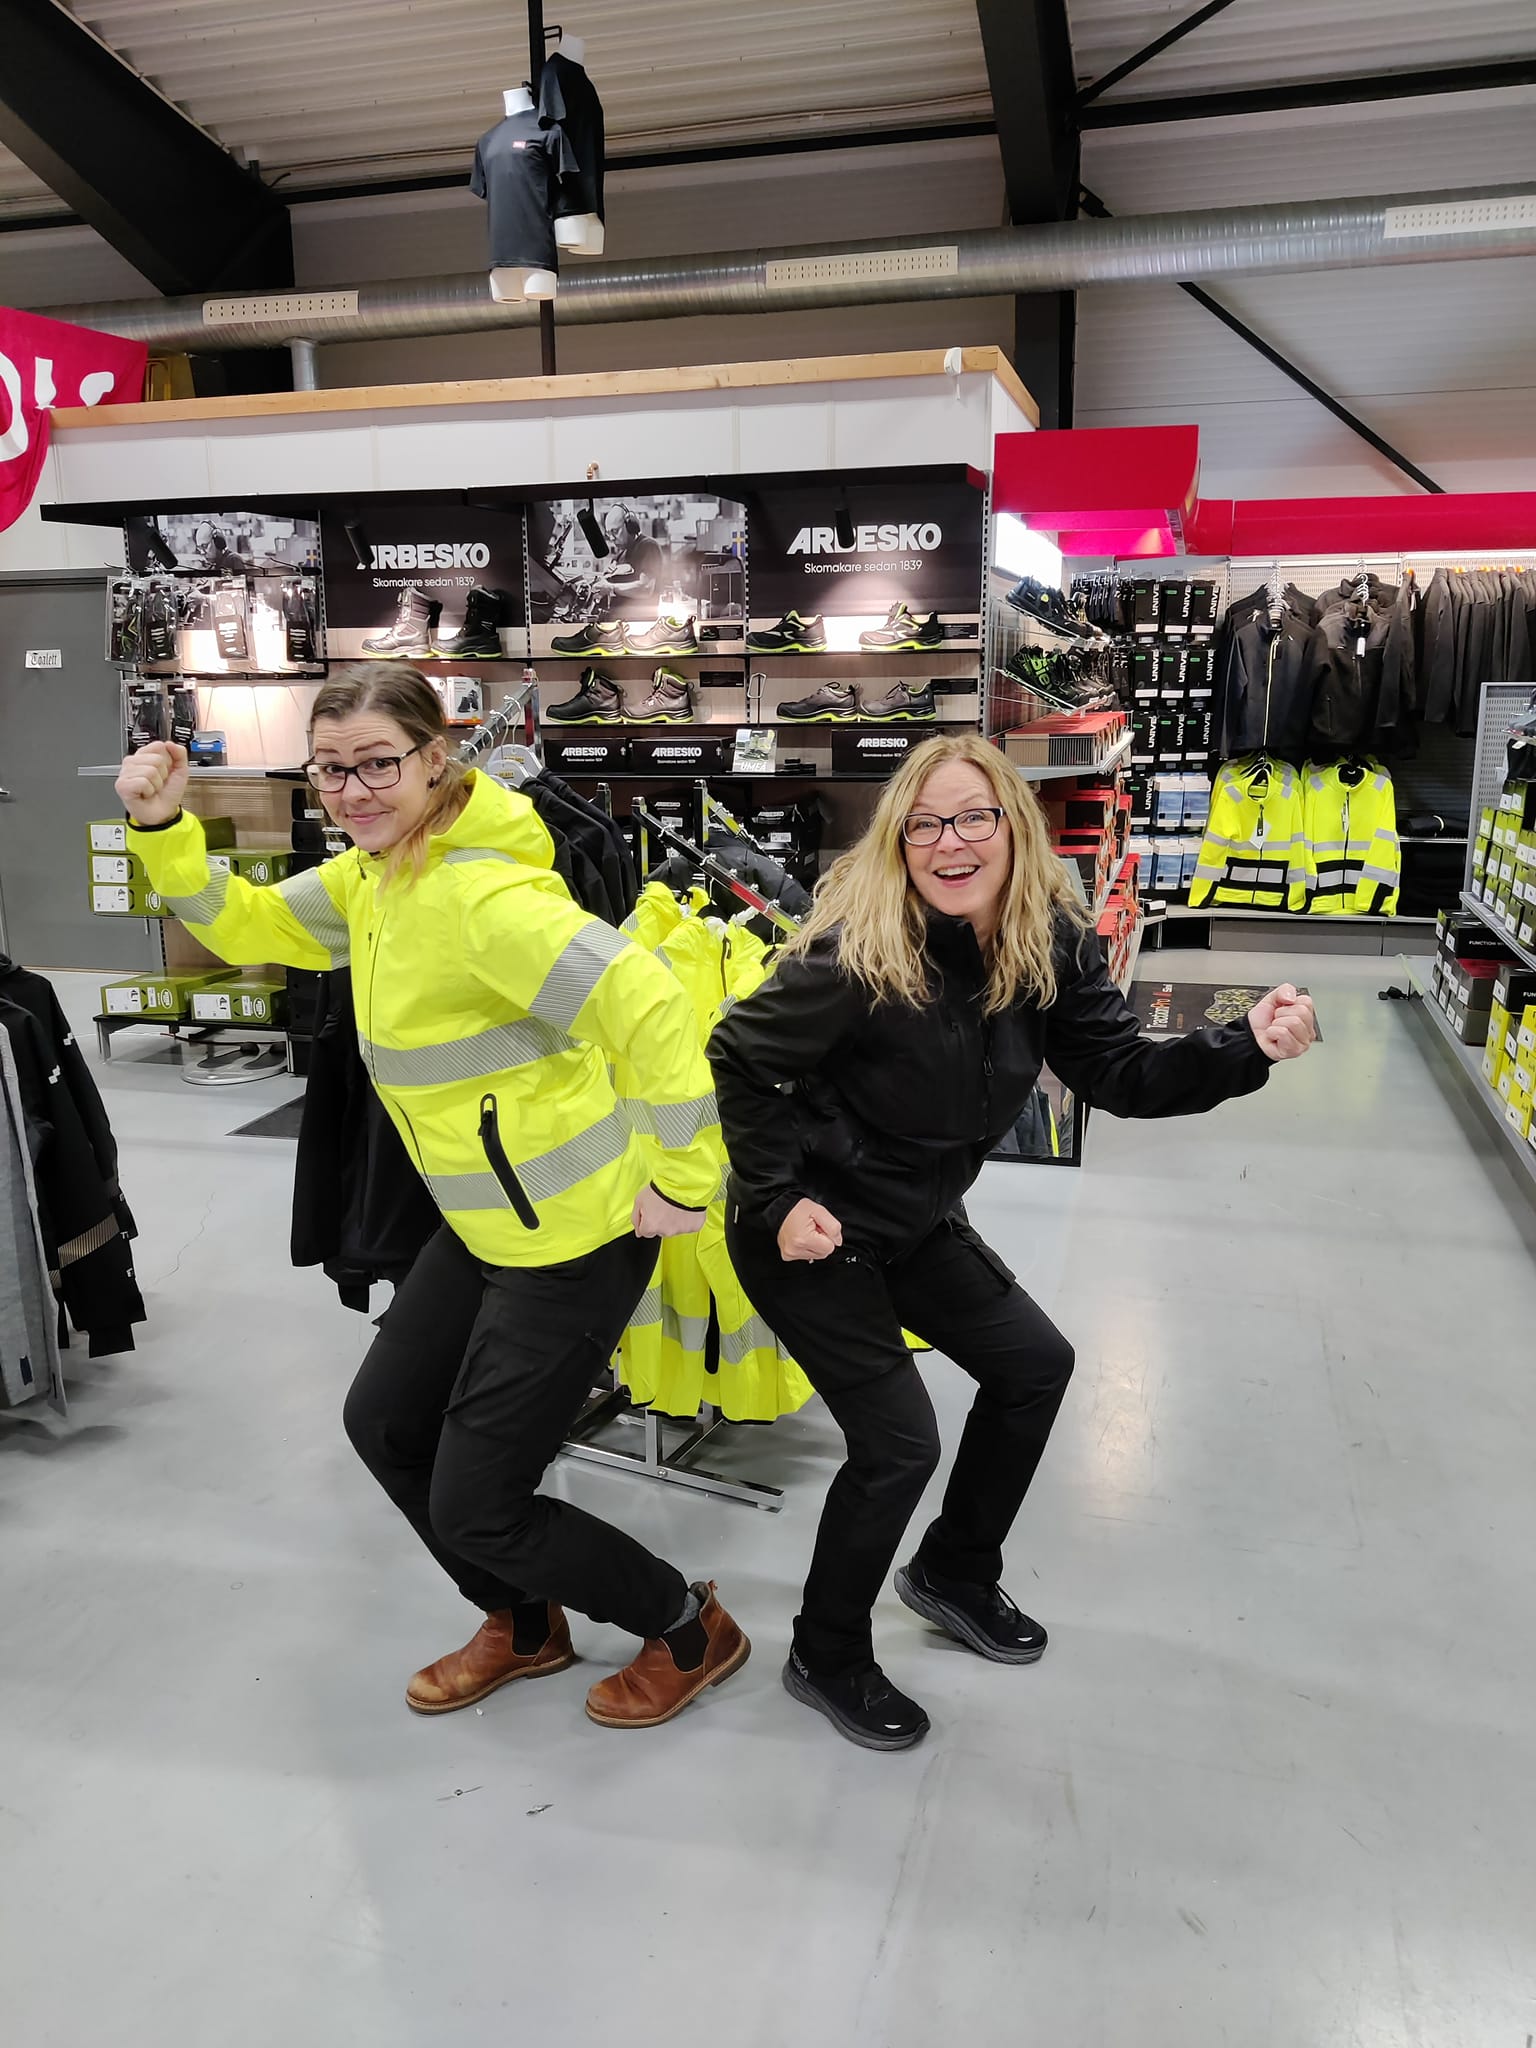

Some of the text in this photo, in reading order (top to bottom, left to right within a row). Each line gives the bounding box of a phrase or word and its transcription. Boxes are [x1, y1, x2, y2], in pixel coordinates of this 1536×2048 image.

[804, 560, 922, 574] Skomakare sedan 1839
[372, 576, 475, 588] Skomakare sedan 1839
[856, 738, 908, 748] ARBESKO
[561, 747, 608, 757] ARBESKO
[651, 747, 702, 757] ARBESKO
